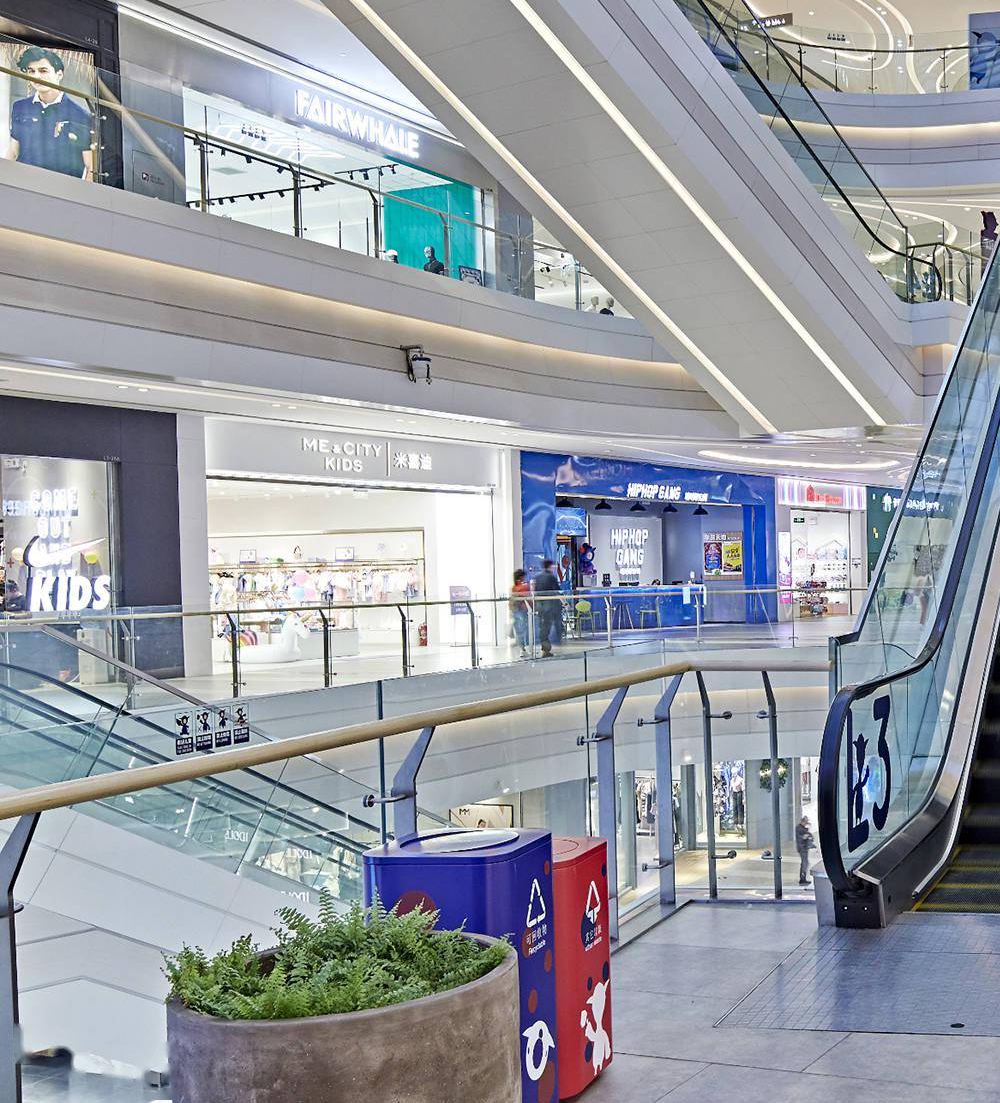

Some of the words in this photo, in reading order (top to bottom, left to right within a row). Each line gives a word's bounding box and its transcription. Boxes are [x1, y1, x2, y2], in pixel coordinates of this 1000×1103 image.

[294, 89, 420, 158] FAIRWHALE
[324, 457, 363, 473] KIDS
[626, 482, 659, 500] HIPHOP
[659, 485, 682, 501] GANG
[610, 528, 649, 546] HIPHOP
[615, 548, 645, 566] GANG
[28, 575, 112, 612] KIDS
